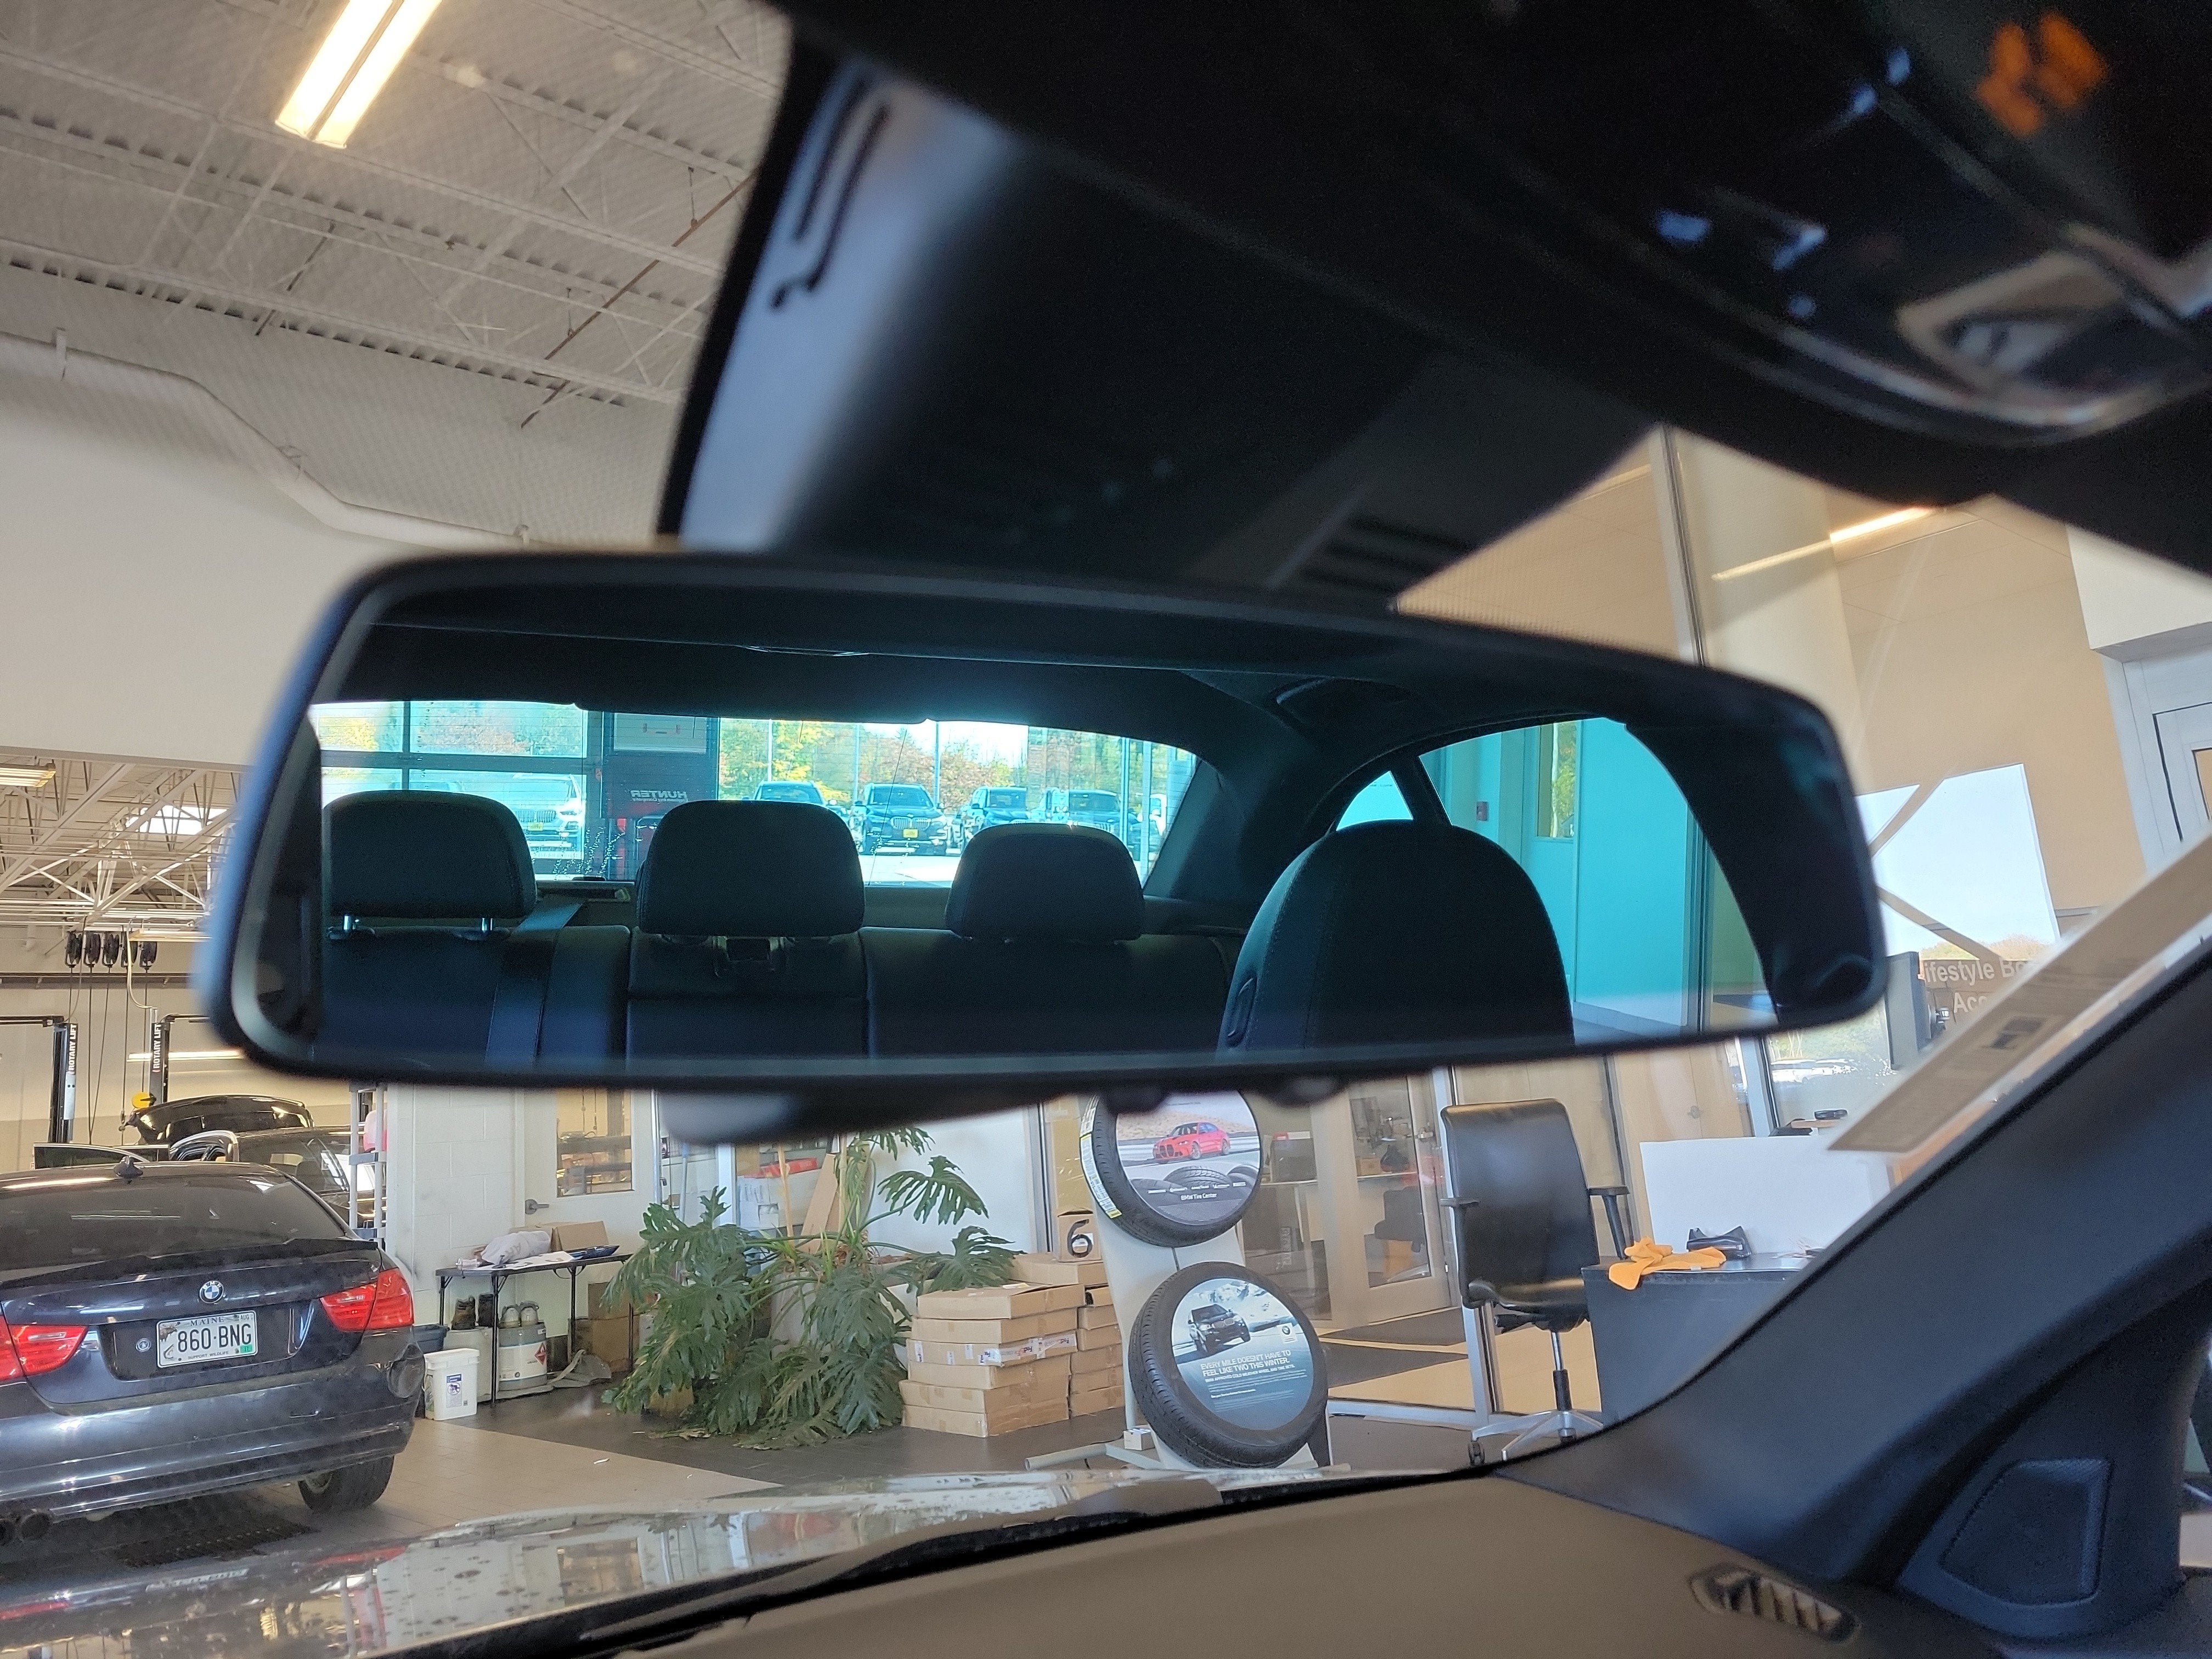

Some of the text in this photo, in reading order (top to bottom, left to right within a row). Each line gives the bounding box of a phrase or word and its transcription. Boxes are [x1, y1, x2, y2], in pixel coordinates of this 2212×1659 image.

[1925, 957, 2028, 986] ifestyle Bo
[1954, 992, 1988, 1013] Acc
[153, 1023, 162, 1069] ROTARY LIFT
[1067, 1219, 1093, 1258] 6
[190, 1317, 224, 1326] MAINE
[1221, 1358, 1236, 1368] MILE
[1237, 1355, 1264, 1363] DOESN'T
[1265, 1351, 1280, 1359] HAVE
[1249, 1361, 1264, 1369] THIS
[1264, 1357, 1290, 1367] WINTER.
